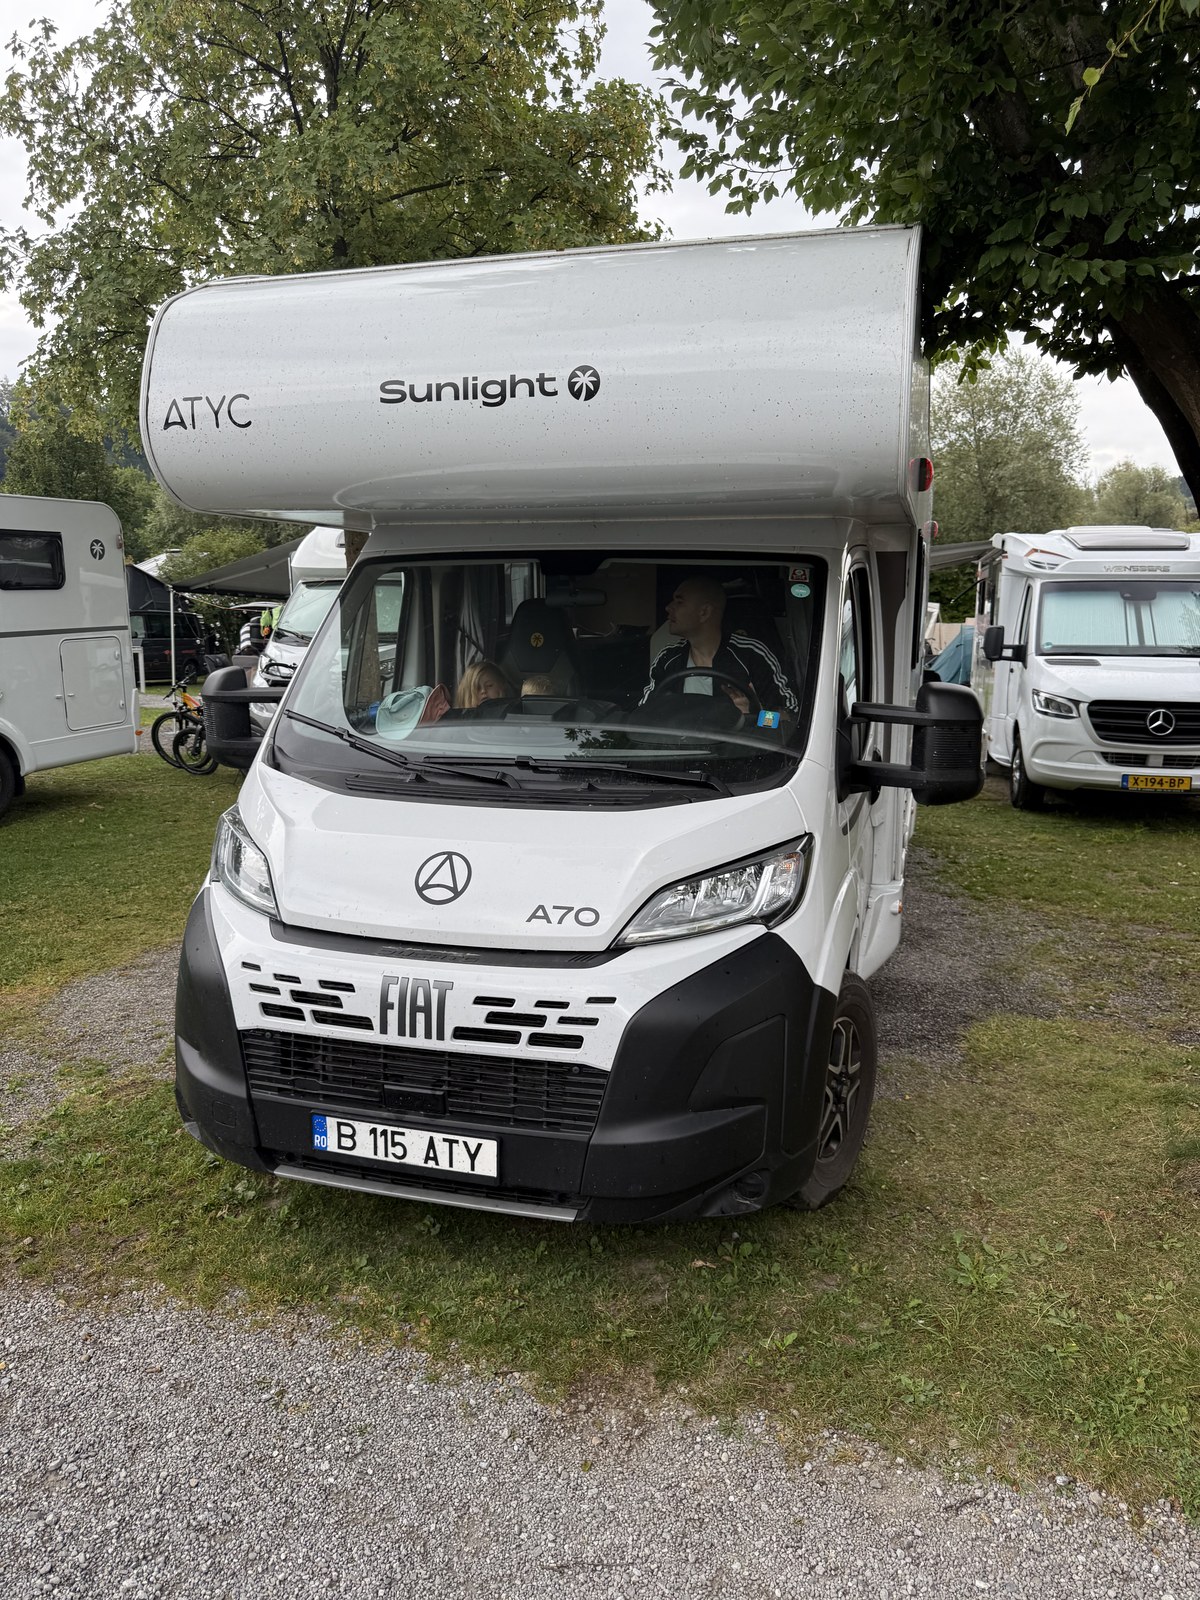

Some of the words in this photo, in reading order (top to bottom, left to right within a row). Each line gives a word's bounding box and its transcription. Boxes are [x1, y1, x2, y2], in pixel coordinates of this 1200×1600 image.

[379, 372, 559, 408] Sunlight
[163, 393, 252, 430] ATYC
[1132, 776, 1185, 788] X-194-BP
[525, 904, 600, 927] A70
[379, 974, 454, 1041] FIAT
[314, 1134, 327, 1148] RO
[336, 1120, 357, 1152] B
[369, 1127, 408, 1161] 115
[423, 1135, 483, 1172] ATY
